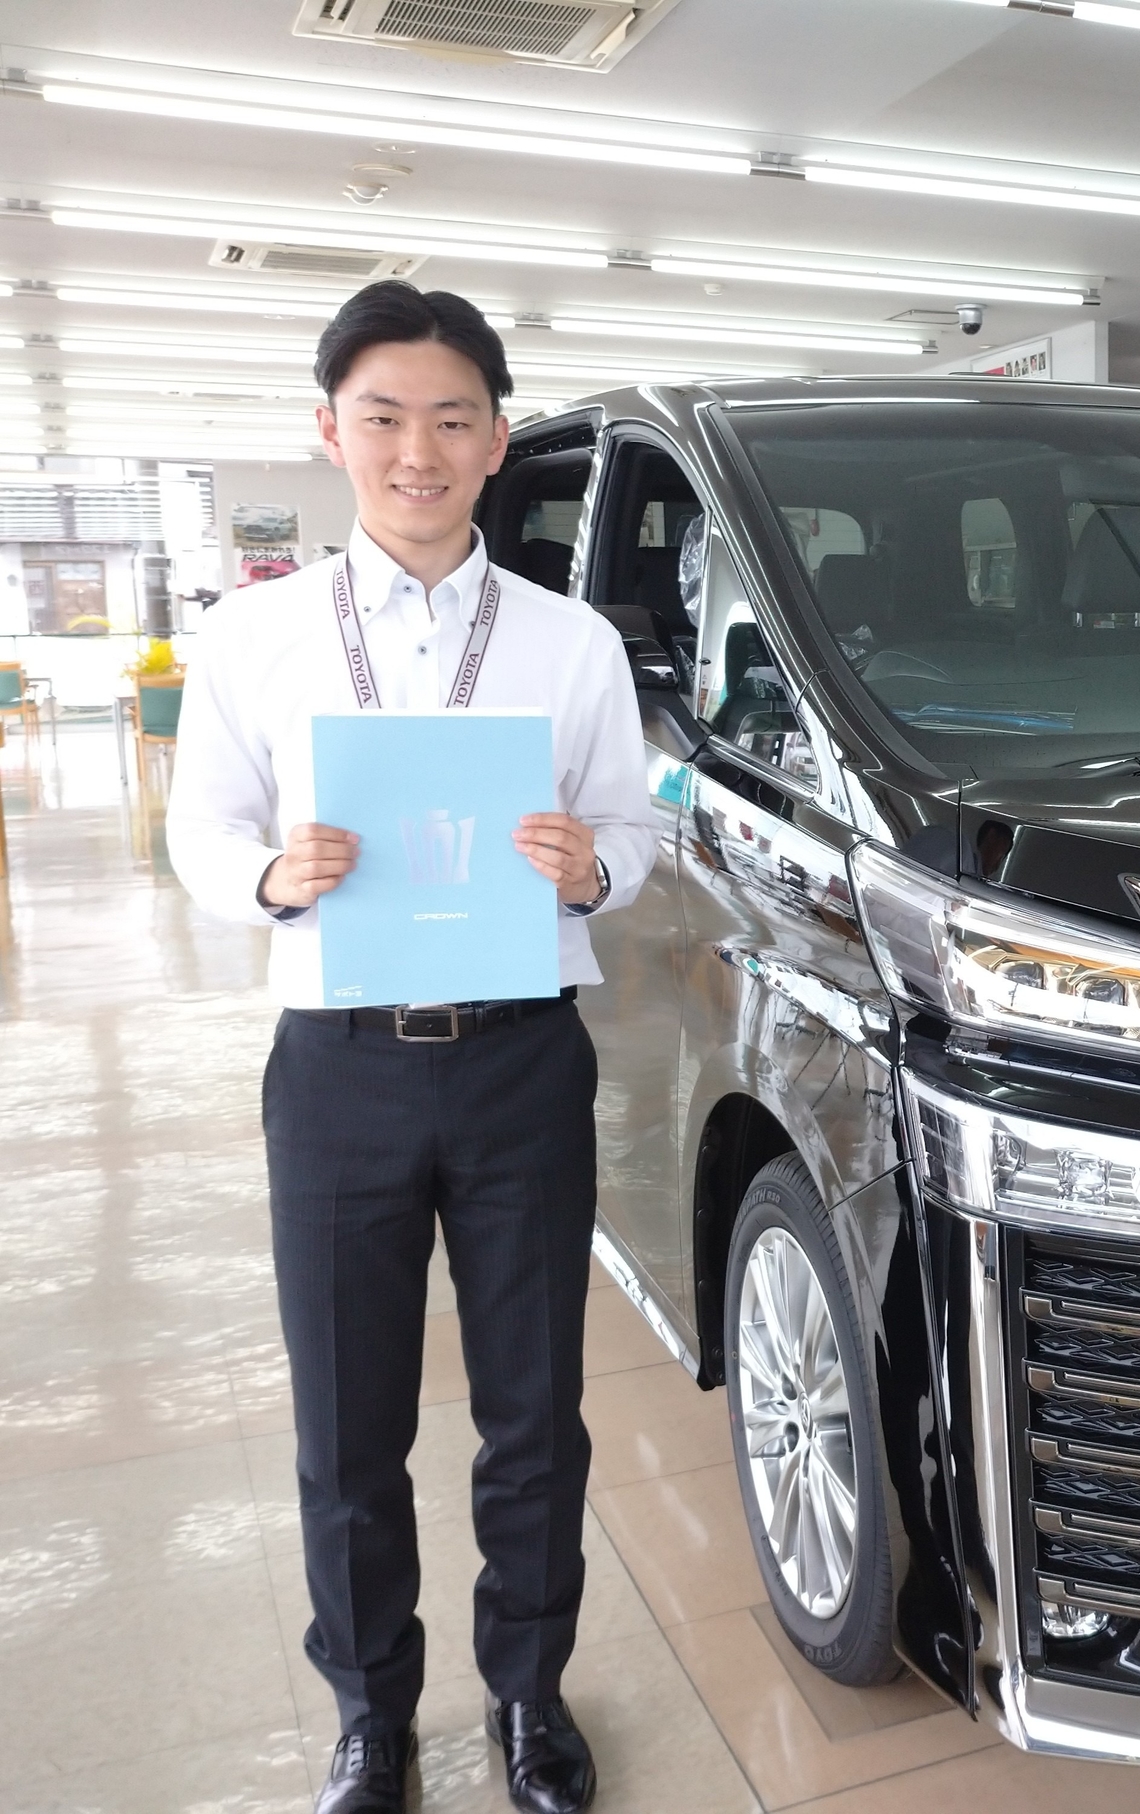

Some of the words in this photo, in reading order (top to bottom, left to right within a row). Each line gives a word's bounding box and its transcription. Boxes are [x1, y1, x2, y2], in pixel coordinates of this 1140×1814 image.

[336, 567, 350, 620] TOYOTA
[479, 579, 498, 627] TOYOTA
[350, 644, 373, 704] TOYOTA
[453, 652, 480, 706] TOYOTA
[414, 912, 469, 920] CROWN
